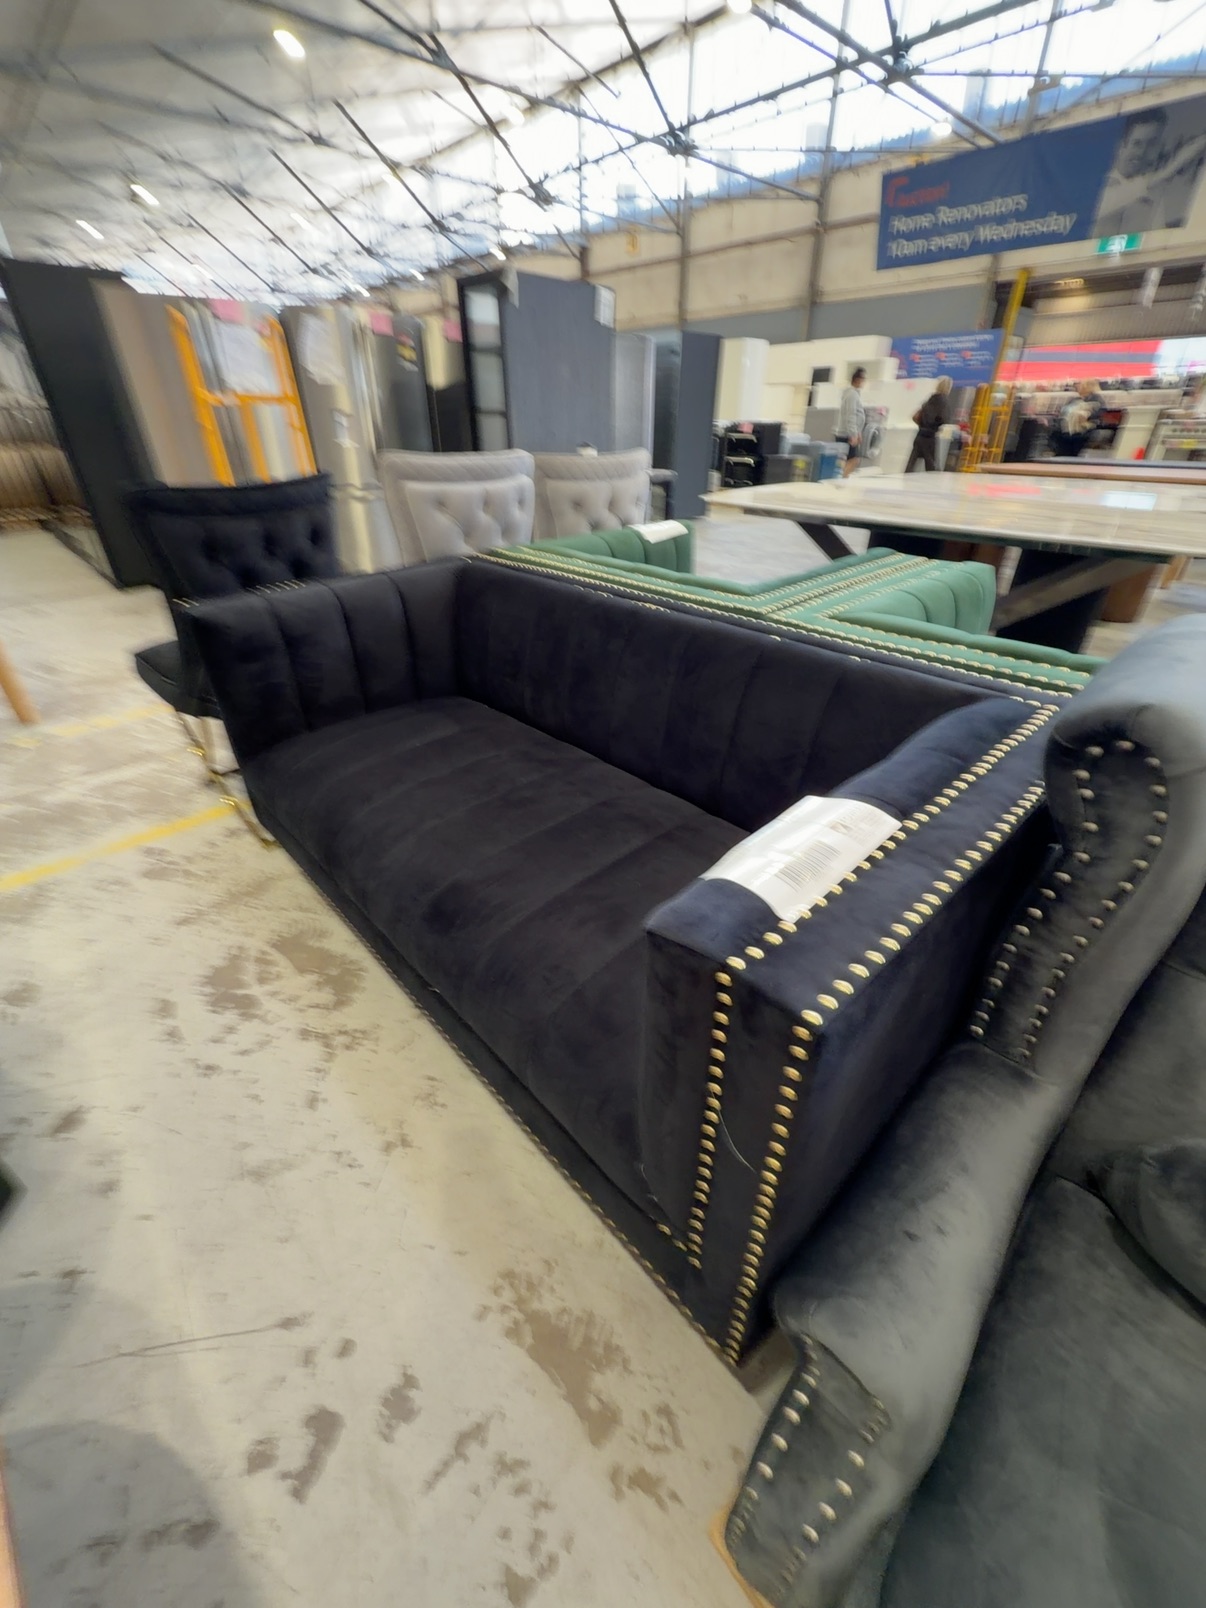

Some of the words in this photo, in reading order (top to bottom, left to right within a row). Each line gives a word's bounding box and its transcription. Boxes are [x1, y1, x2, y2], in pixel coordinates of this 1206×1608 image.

[888, 238, 927, 258] 10am
[928, 230, 974, 252] every
[975, 211, 1077, 243] Wednesday
[890, 213, 935, 234] Home
[936, 194, 1028, 225] Renovators
